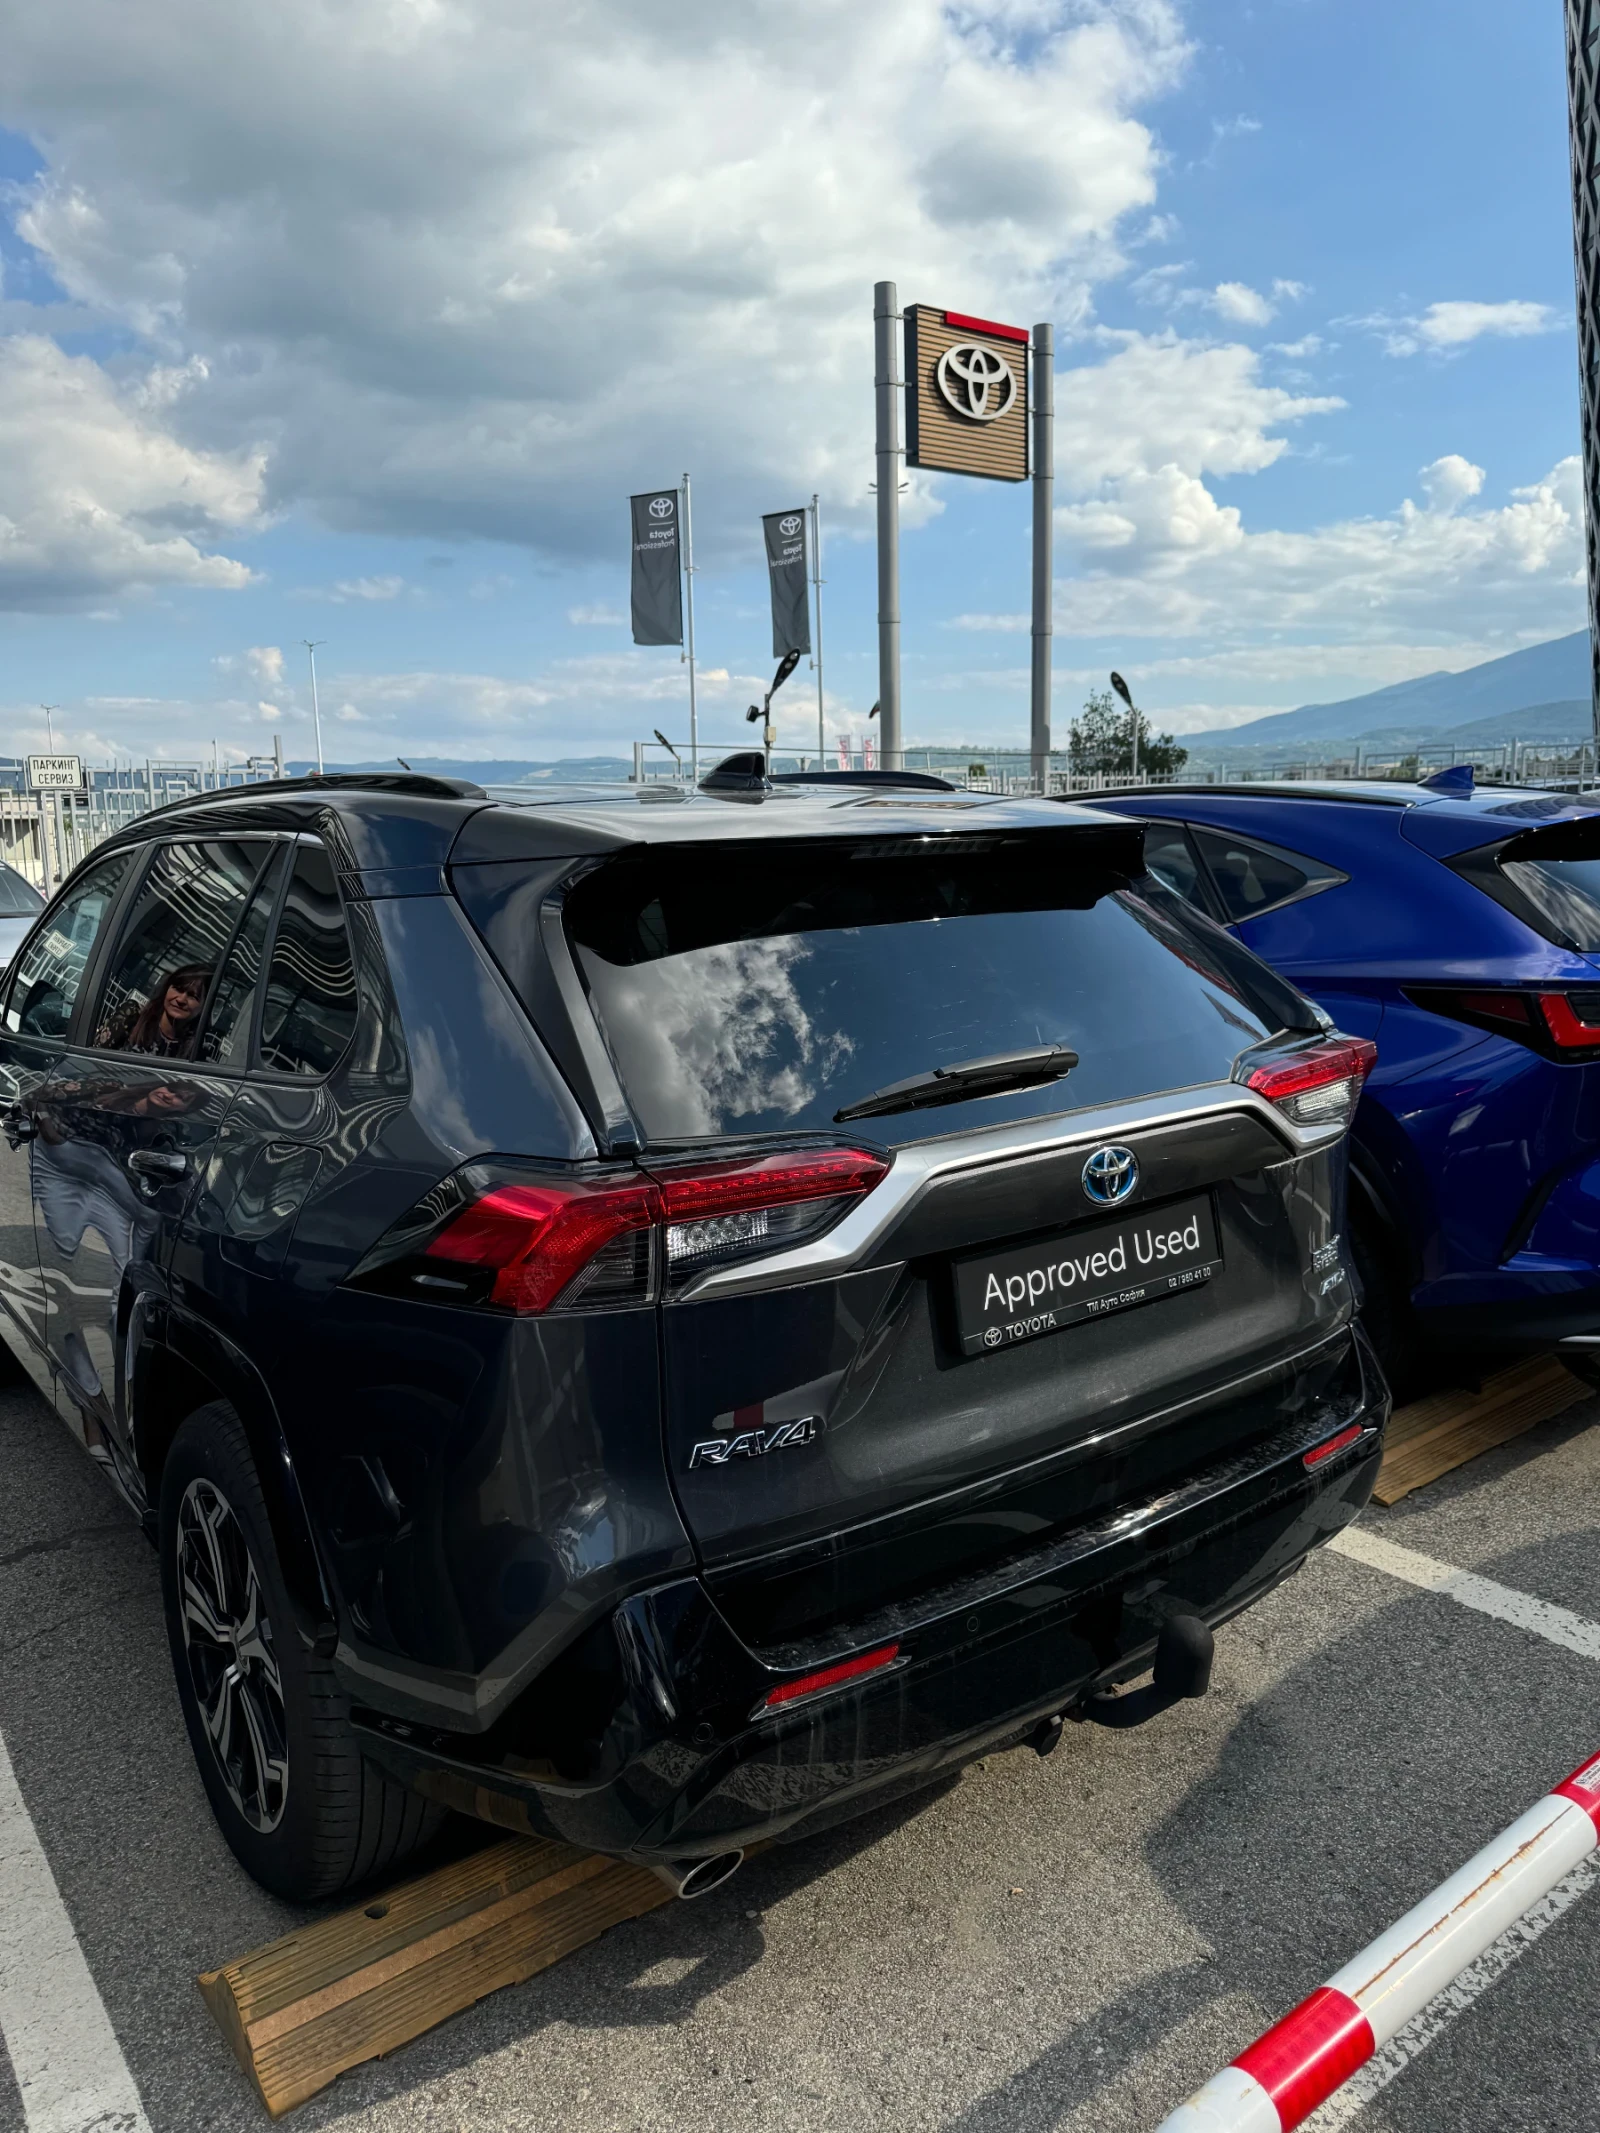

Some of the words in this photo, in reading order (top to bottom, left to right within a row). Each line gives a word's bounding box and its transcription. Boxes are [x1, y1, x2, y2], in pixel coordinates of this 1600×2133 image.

[32, 759, 76, 770] ПАРКИНГ
[38, 773, 74, 785] СЕРВИЗ
[983, 1235, 1127, 1313] Approved
[1133, 1214, 1200, 1264] Used
[1168, 1277, 1177, 1288] 02
[1100, 1297, 1119, 1310] Ауто
[1119, 1289, 1146, 1303] София
[1005, 1313, 1057, 1339] TOYOTA
[688, 1416, 817, 1469] RAV4
